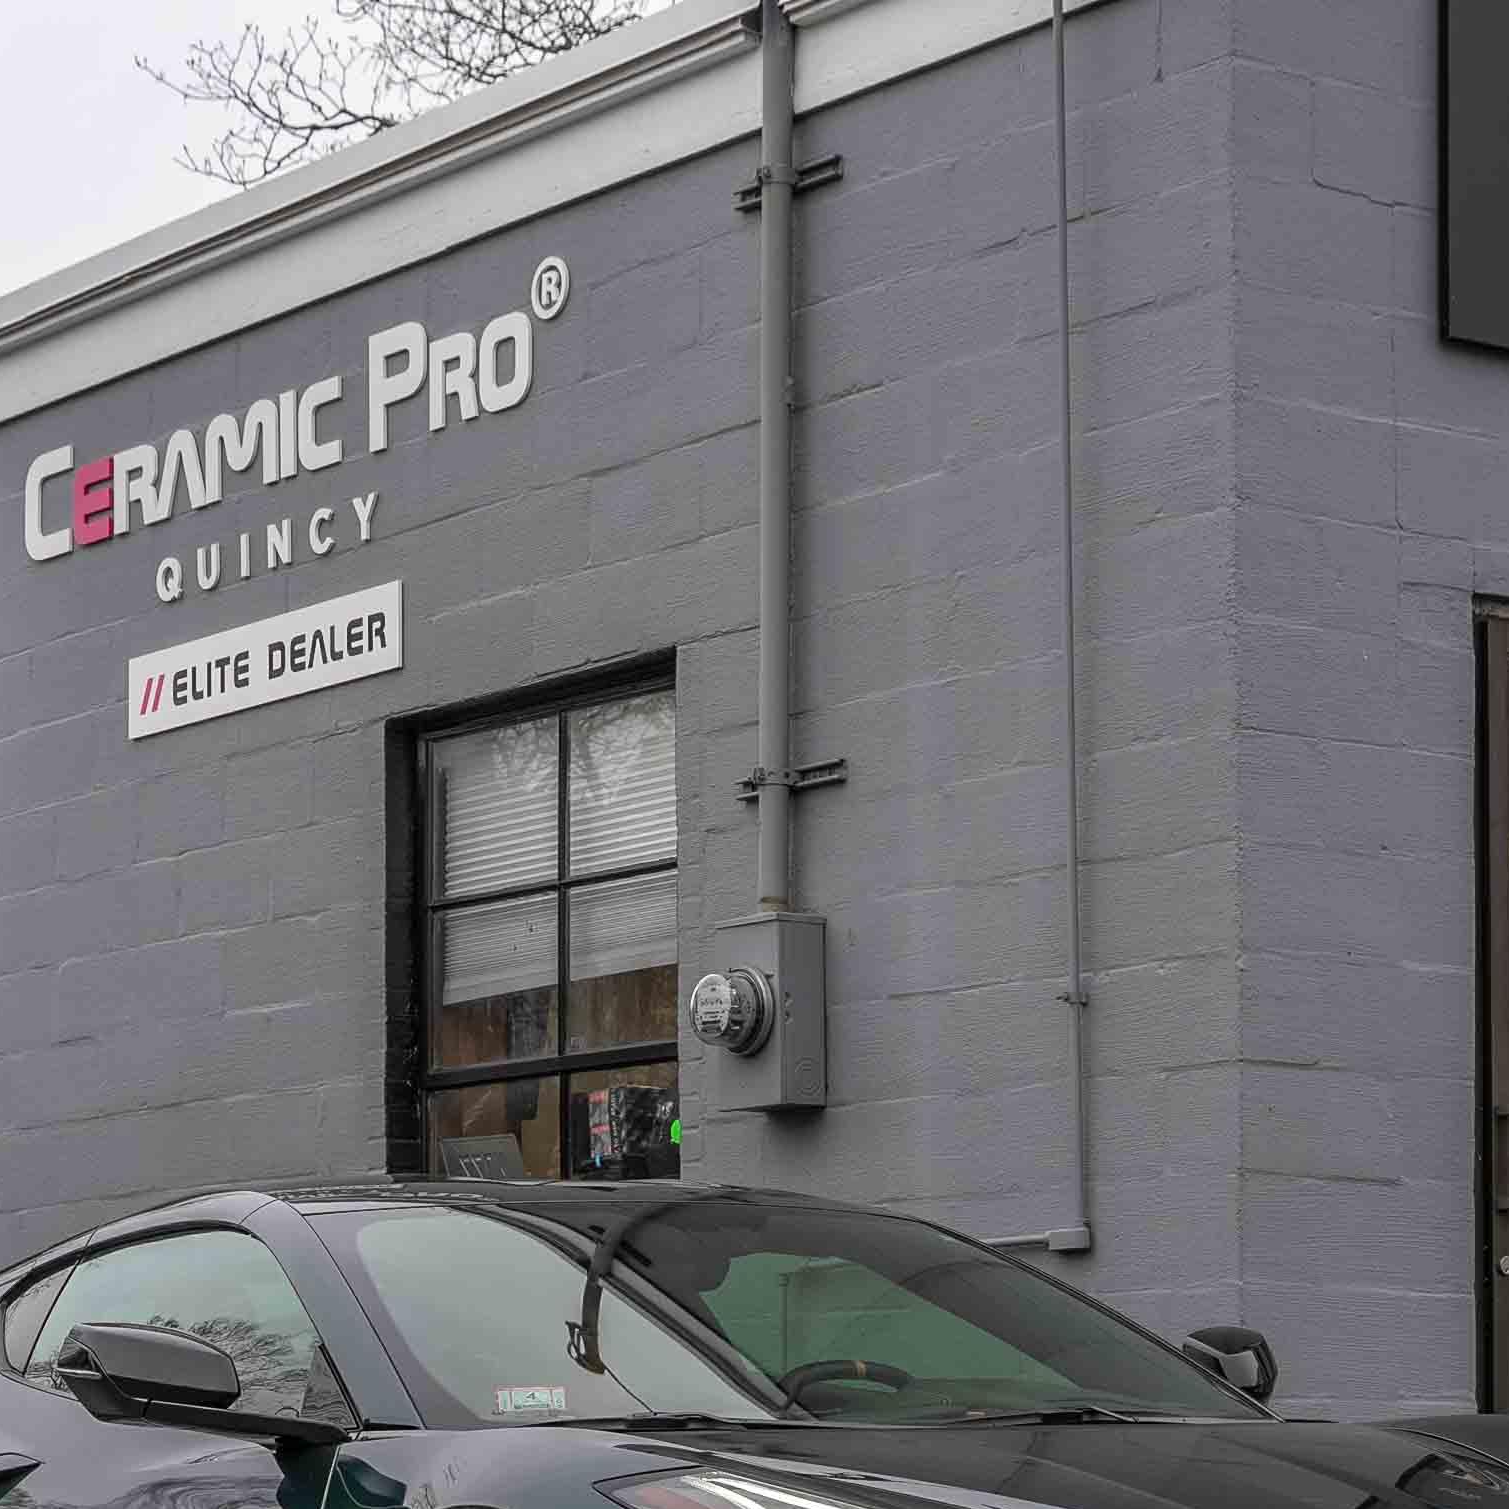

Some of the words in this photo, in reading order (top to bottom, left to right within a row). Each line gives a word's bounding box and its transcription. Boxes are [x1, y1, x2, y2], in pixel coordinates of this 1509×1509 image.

[24, 375, 344, 561] CERAMIC
[155, 491, 379, 602] QUINCY
[268, 611, 388, 681] DEALER
